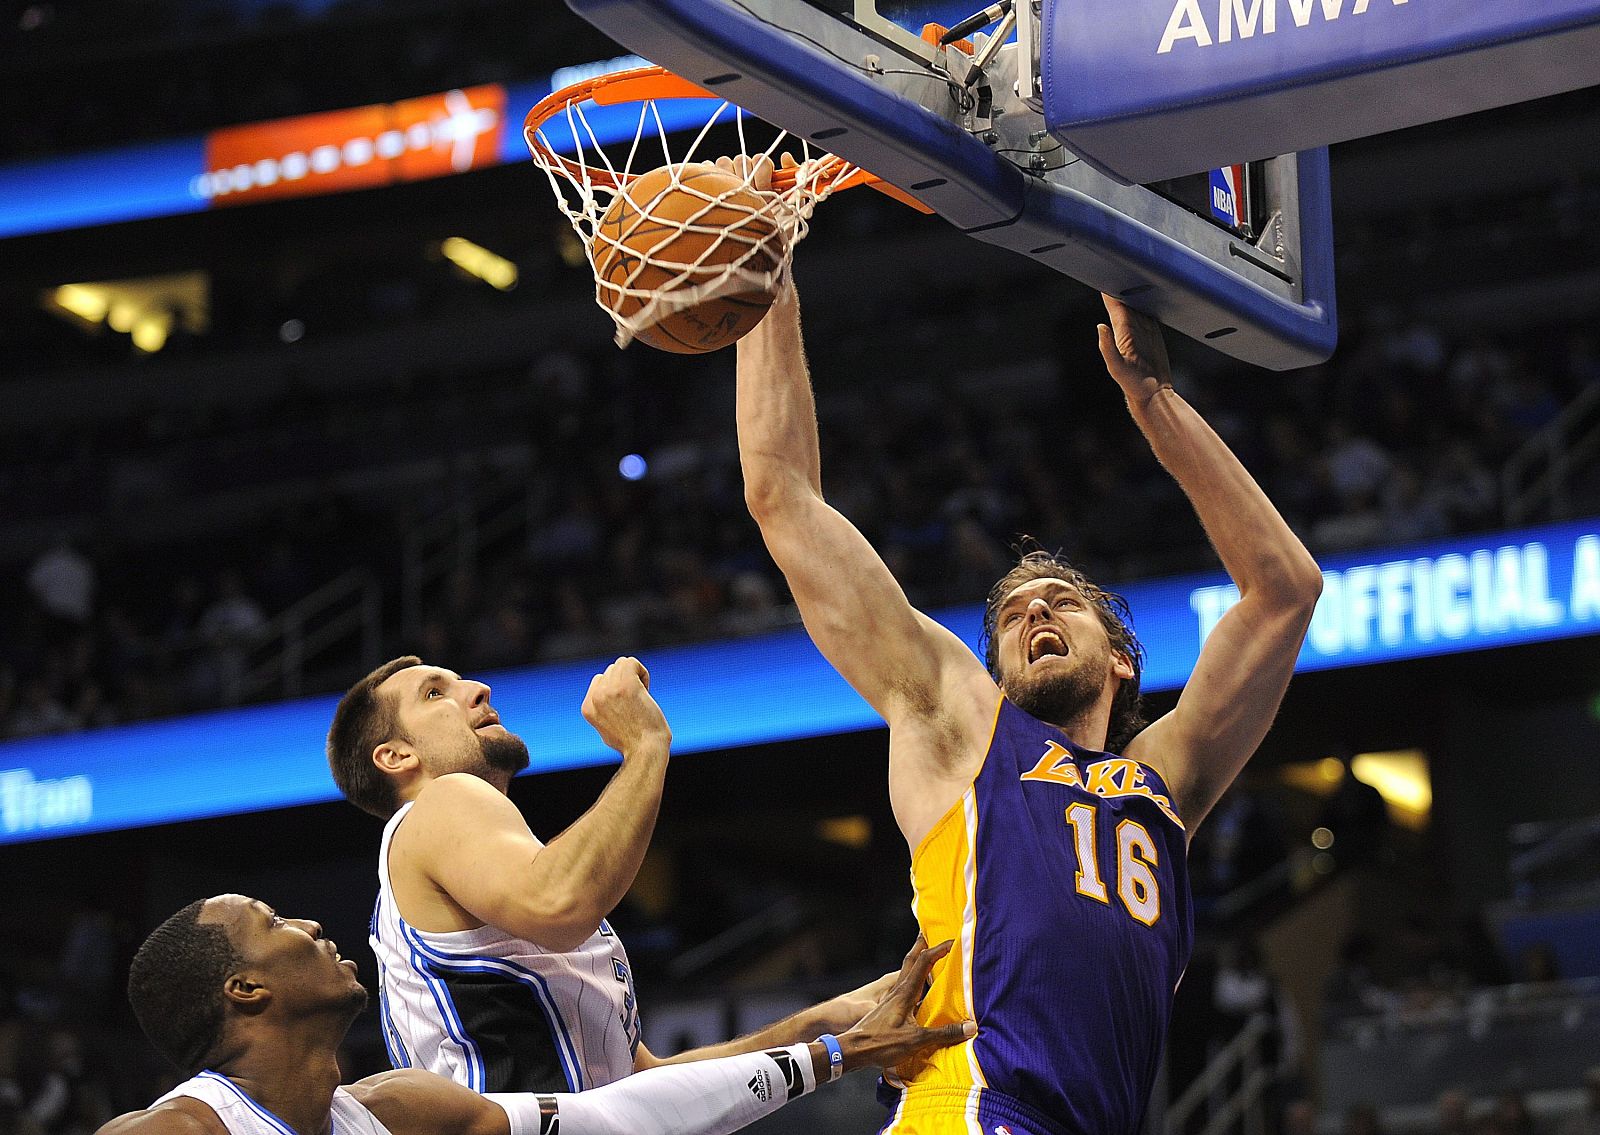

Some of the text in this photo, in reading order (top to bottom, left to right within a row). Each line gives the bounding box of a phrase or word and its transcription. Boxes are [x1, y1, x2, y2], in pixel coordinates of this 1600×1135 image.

[1156, 0, 1410, 54] AM
[1213, 185, 1233, 216] NBA
[1309, 541, 1564, 656] OFFICIAL
[1065, 801, 1161, 927] 16
[755, 1068, 767, 1103] adidas
